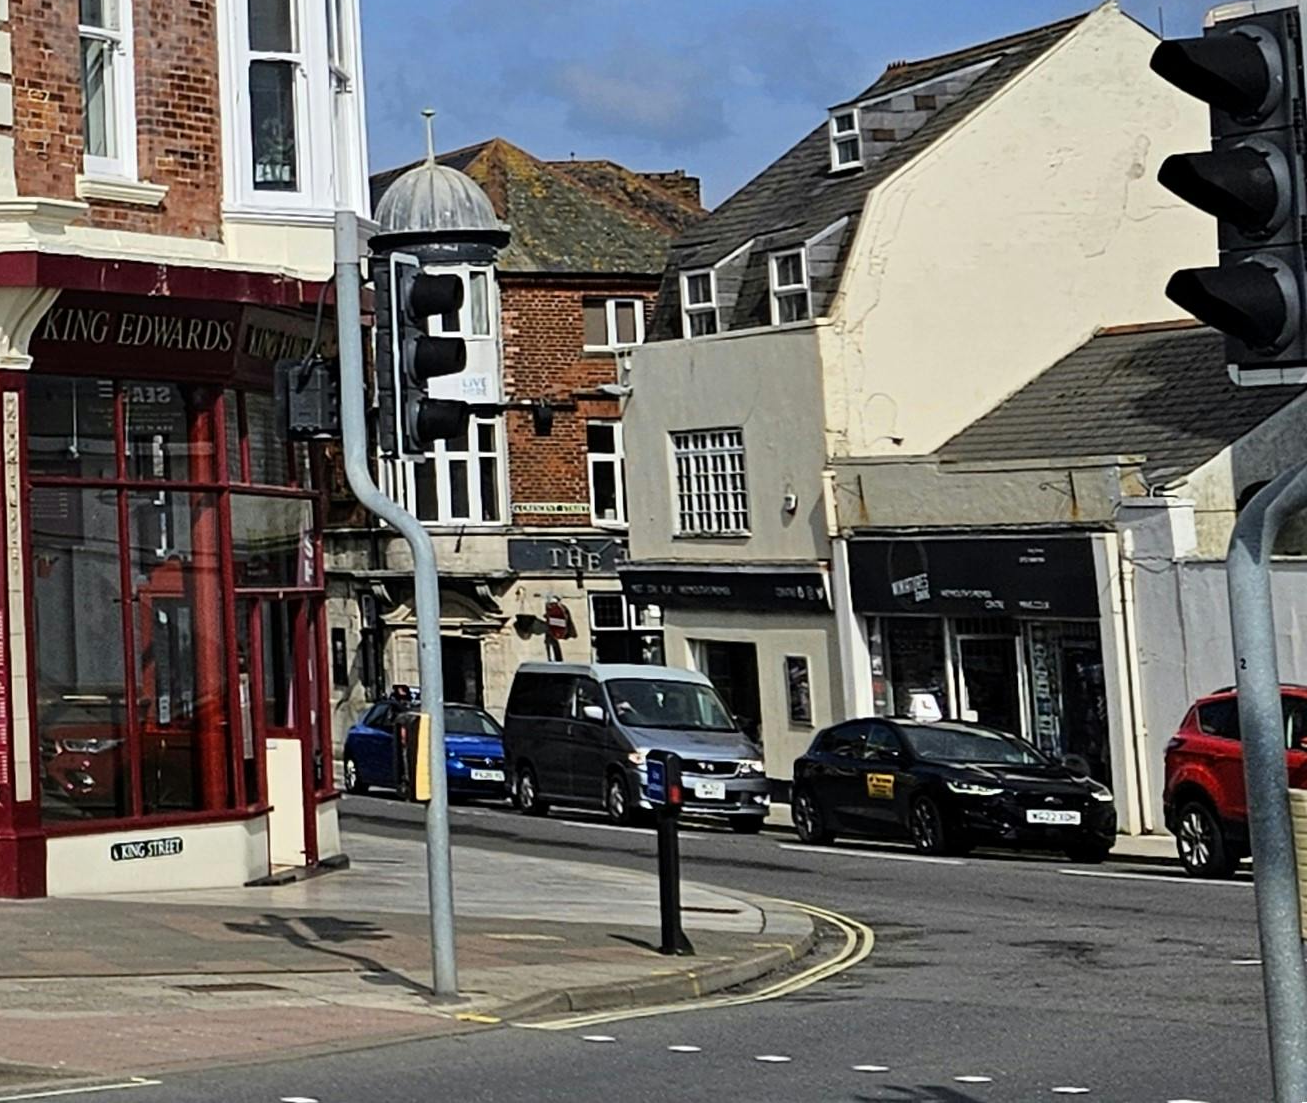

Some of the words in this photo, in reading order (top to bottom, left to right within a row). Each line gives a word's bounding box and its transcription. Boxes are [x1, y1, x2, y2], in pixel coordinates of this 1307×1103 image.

[42, 307, 109, 343] KING
[117, 313, 235, 352] EDWARDS
[549, 547, 602, 571] THE
[1240, 657, 1247, 670] 2
[121, 842, 145, 859] KING
[147, 839, 181, 857] STREET
